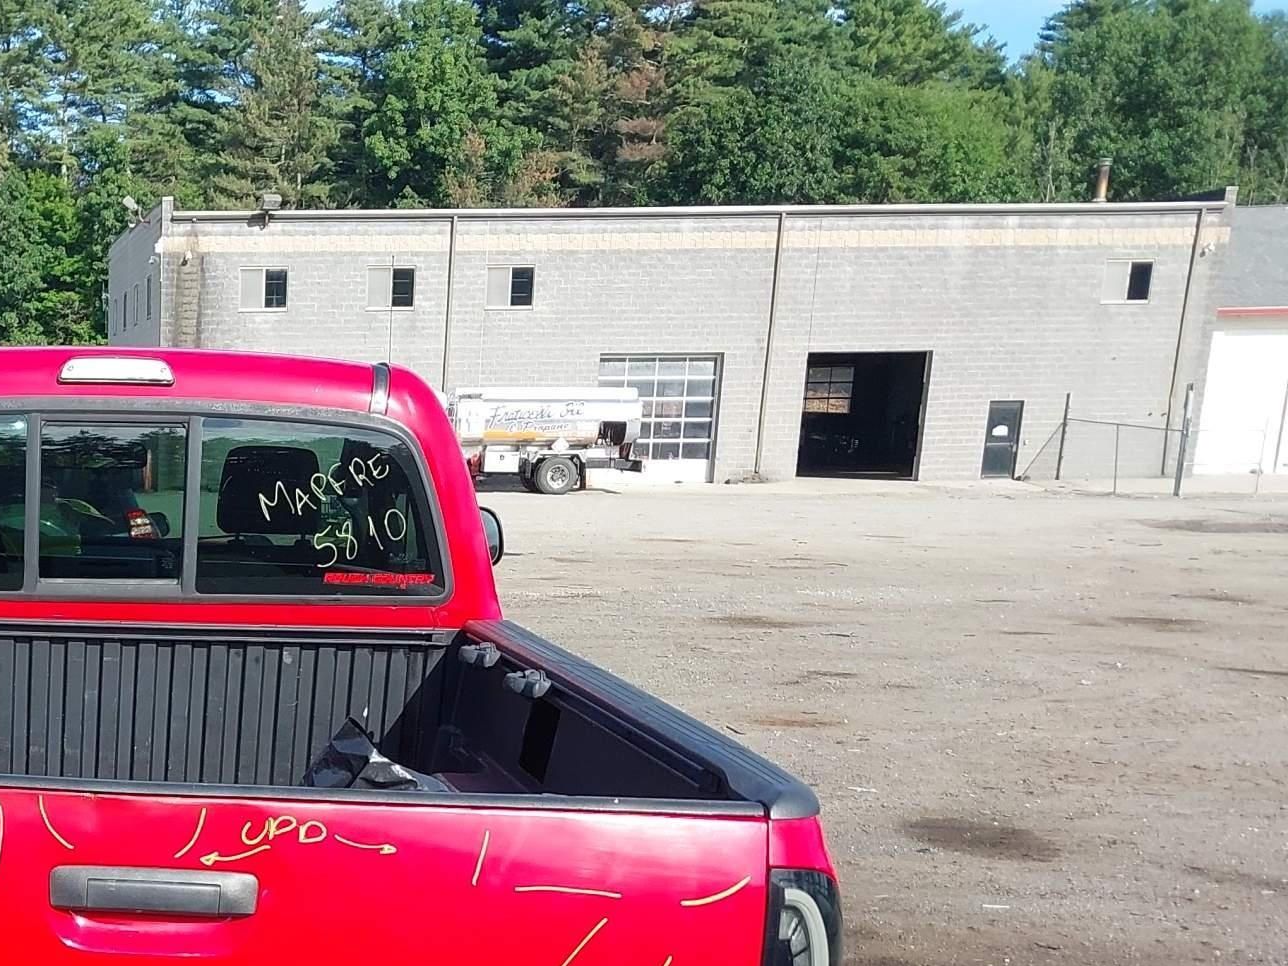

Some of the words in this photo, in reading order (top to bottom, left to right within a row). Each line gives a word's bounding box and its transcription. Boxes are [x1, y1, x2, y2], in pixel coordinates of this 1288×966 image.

[258, 453, 389, 521] MAPFRE
[314, 508, 407, 567] 5810
[241, 815, 328, 845] UPD
